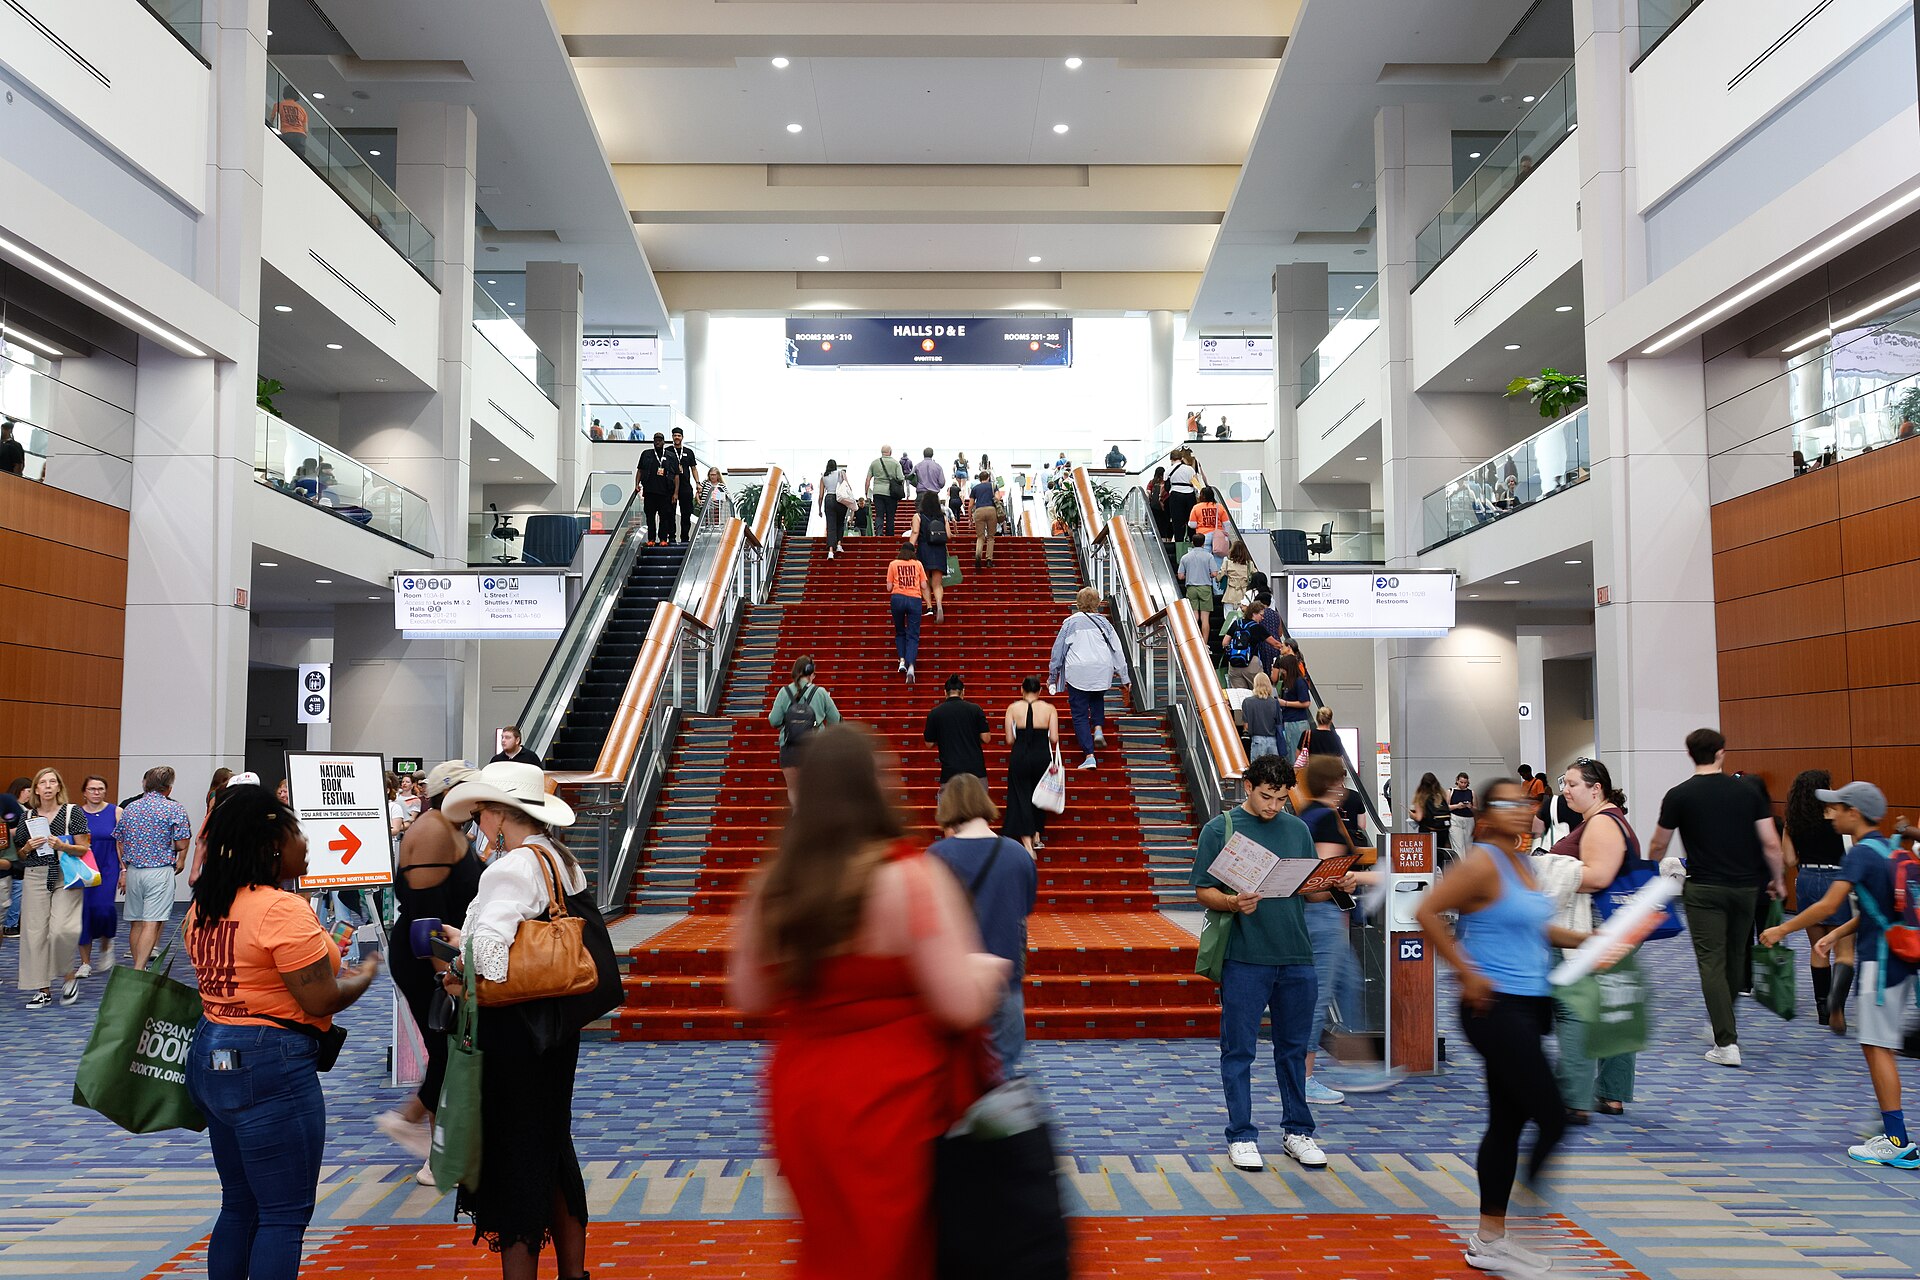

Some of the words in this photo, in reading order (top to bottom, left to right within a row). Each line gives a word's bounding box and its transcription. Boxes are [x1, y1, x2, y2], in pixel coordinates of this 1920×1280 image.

[894, 325, 932, 336] HALLS
[934, 326, 944, 336] D
[946, 325, 956, 336] &
[958, 326, 966, 336] E
[897, 565, 916, 576] EVENT
[898, 576, 916, 586] STAFF
[320, 764, 355, 778] NATIONAL
[321, 778, 342, 792] BOOK
[322, 792, 356, 805] FESTIVAL
[190, 919, 240, 967] EVENT
[1400, 944, 1422, 958] DC
[129, 1061, 186, 1084] BOOKTV.ORG
